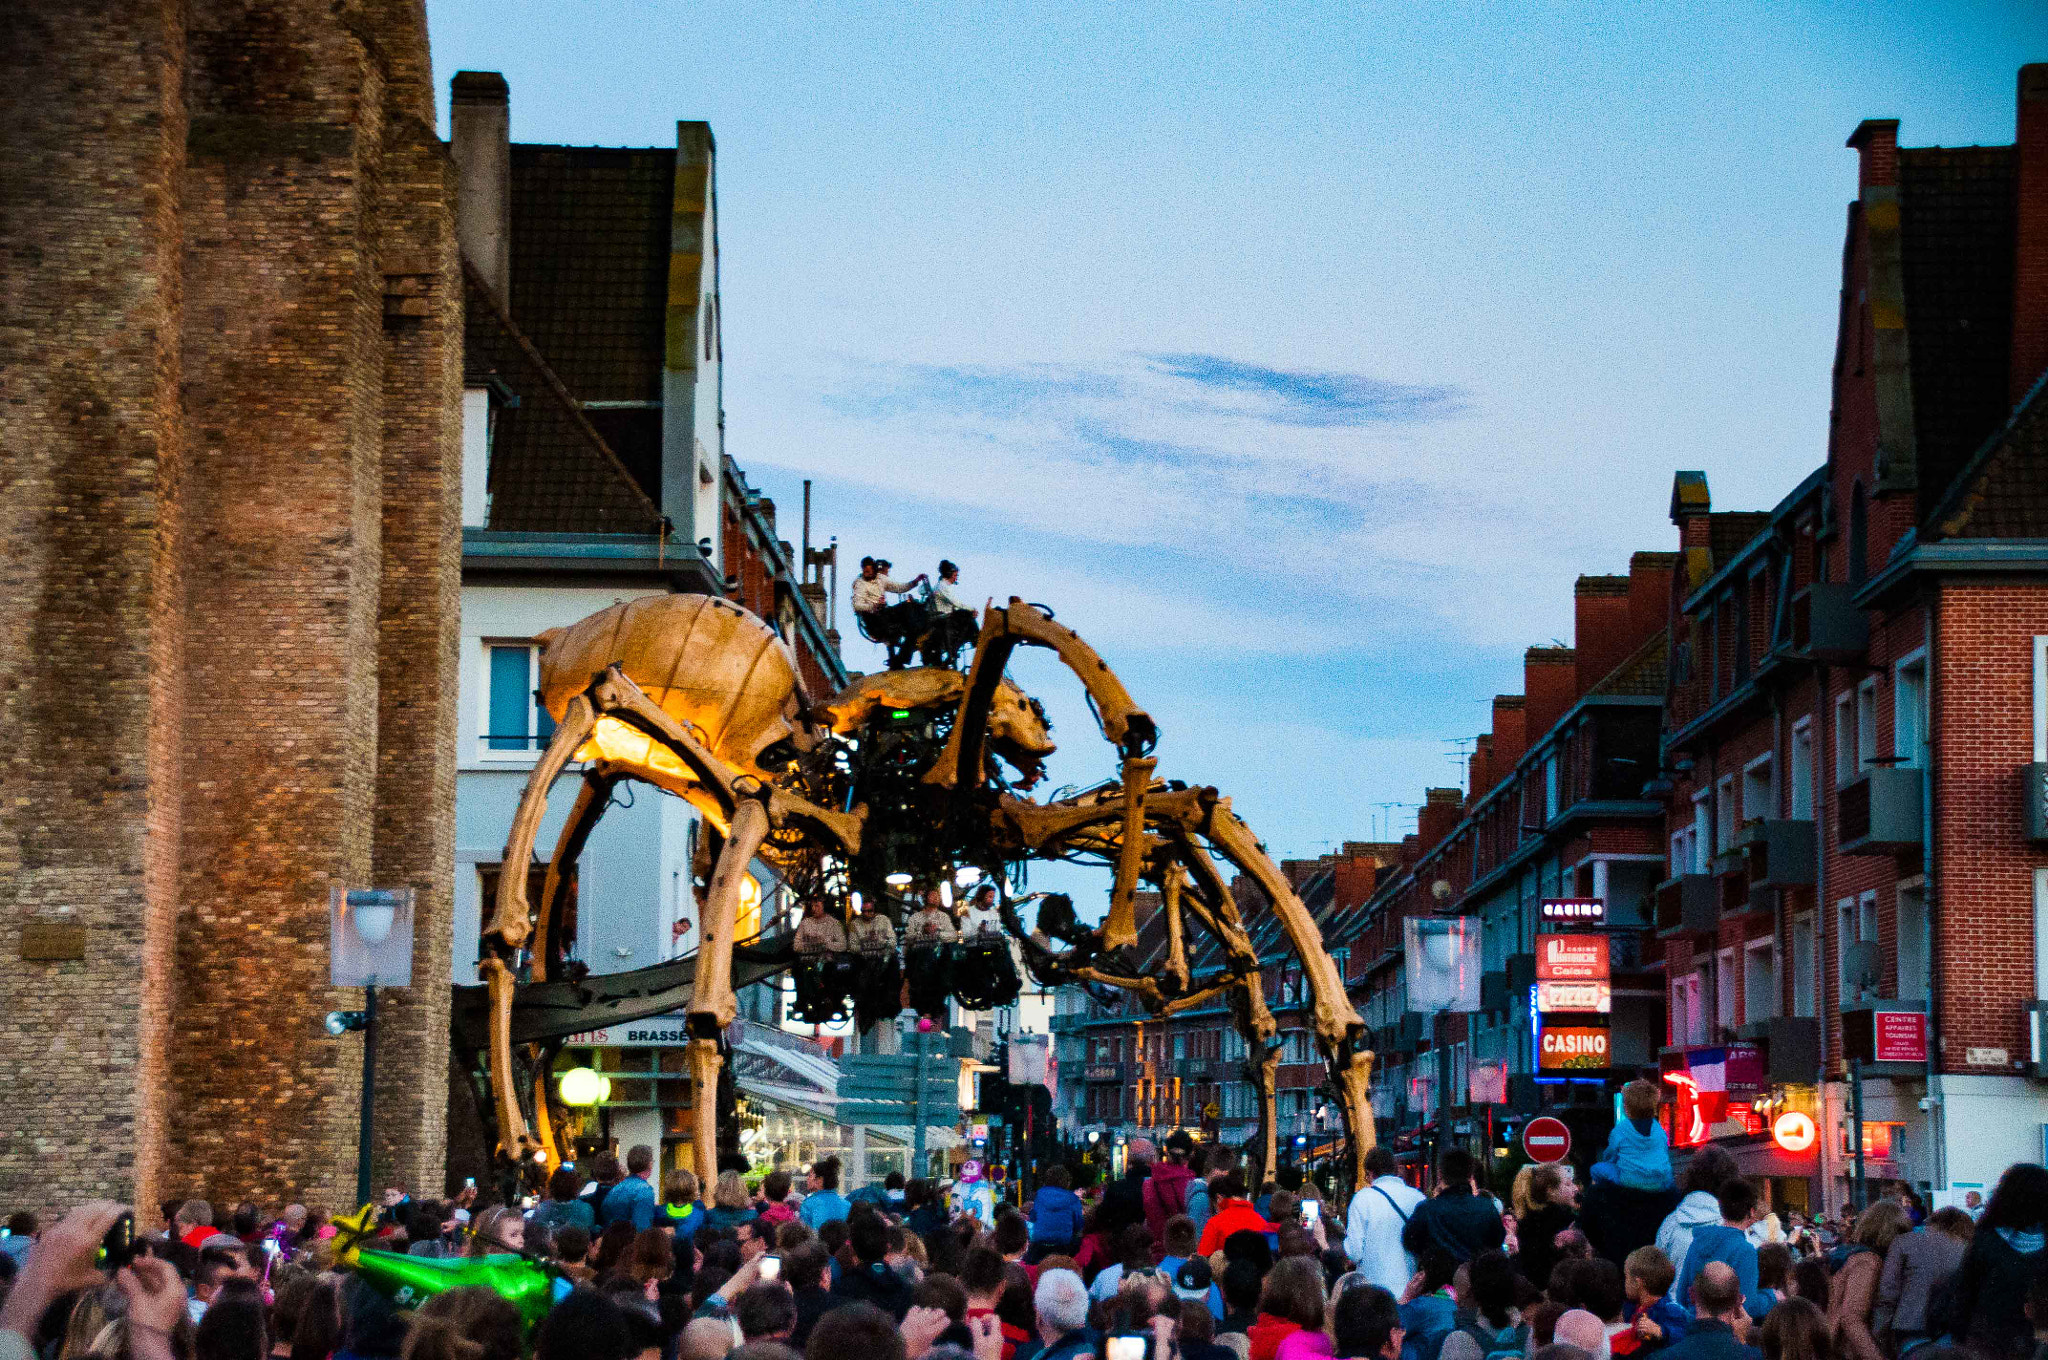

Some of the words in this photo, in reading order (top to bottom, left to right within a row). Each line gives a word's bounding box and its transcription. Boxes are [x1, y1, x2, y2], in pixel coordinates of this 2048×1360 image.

[1543, 904, 1602, 916] CASINO
[1552, 966, 1593, 975] Calais
[1543, 1034, 1606, 1053] CASINO
